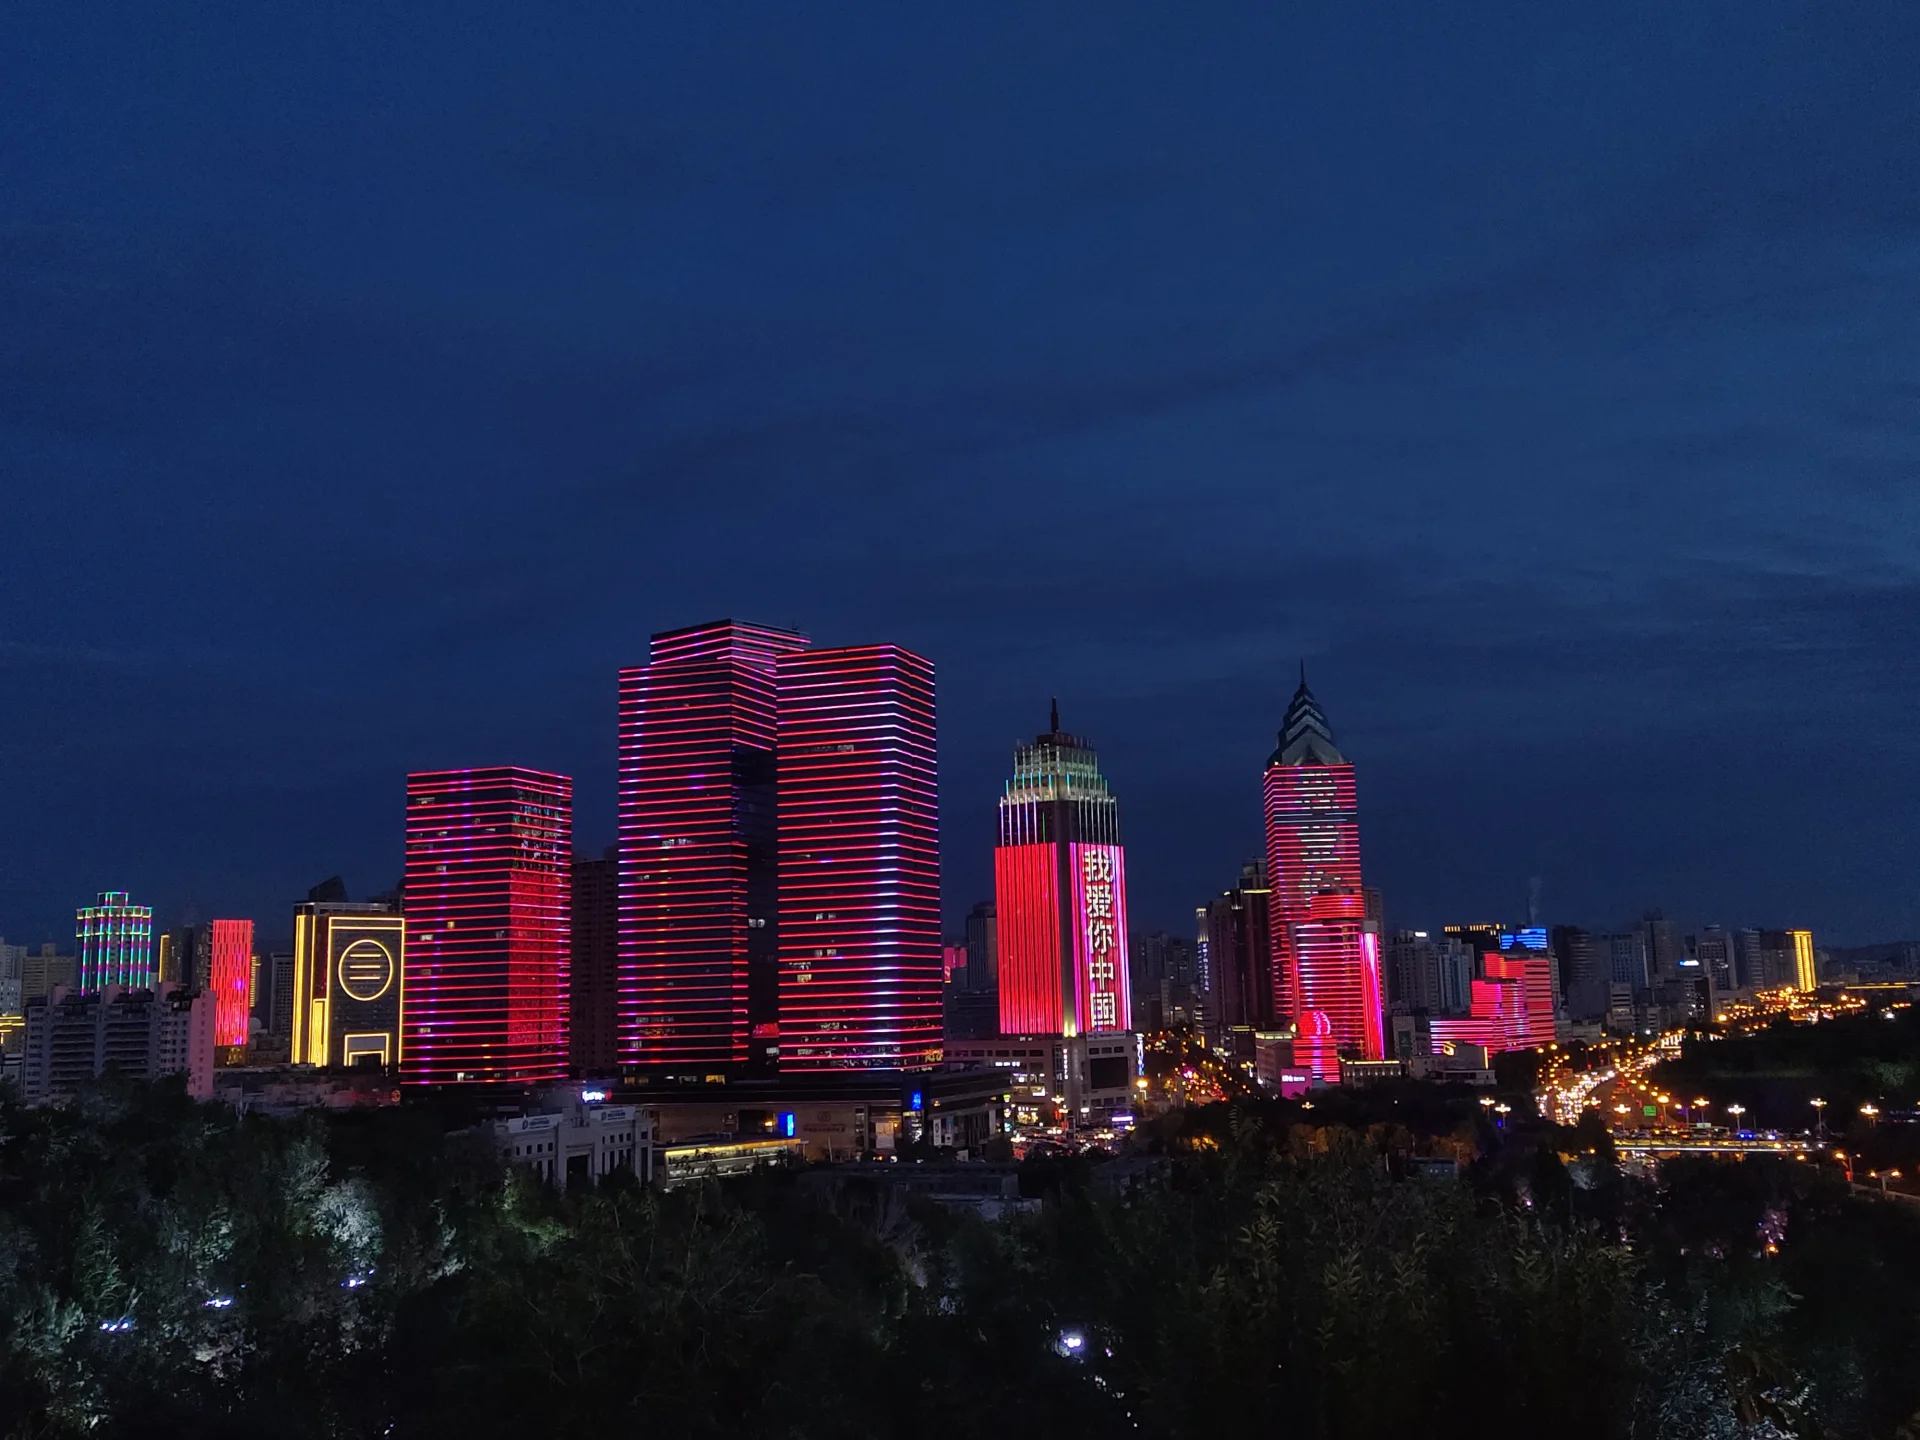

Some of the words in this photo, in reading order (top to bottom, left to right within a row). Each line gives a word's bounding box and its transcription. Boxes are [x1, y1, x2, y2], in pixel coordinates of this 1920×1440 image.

[1083, 847, 1116, 1027] 我爱你中国
